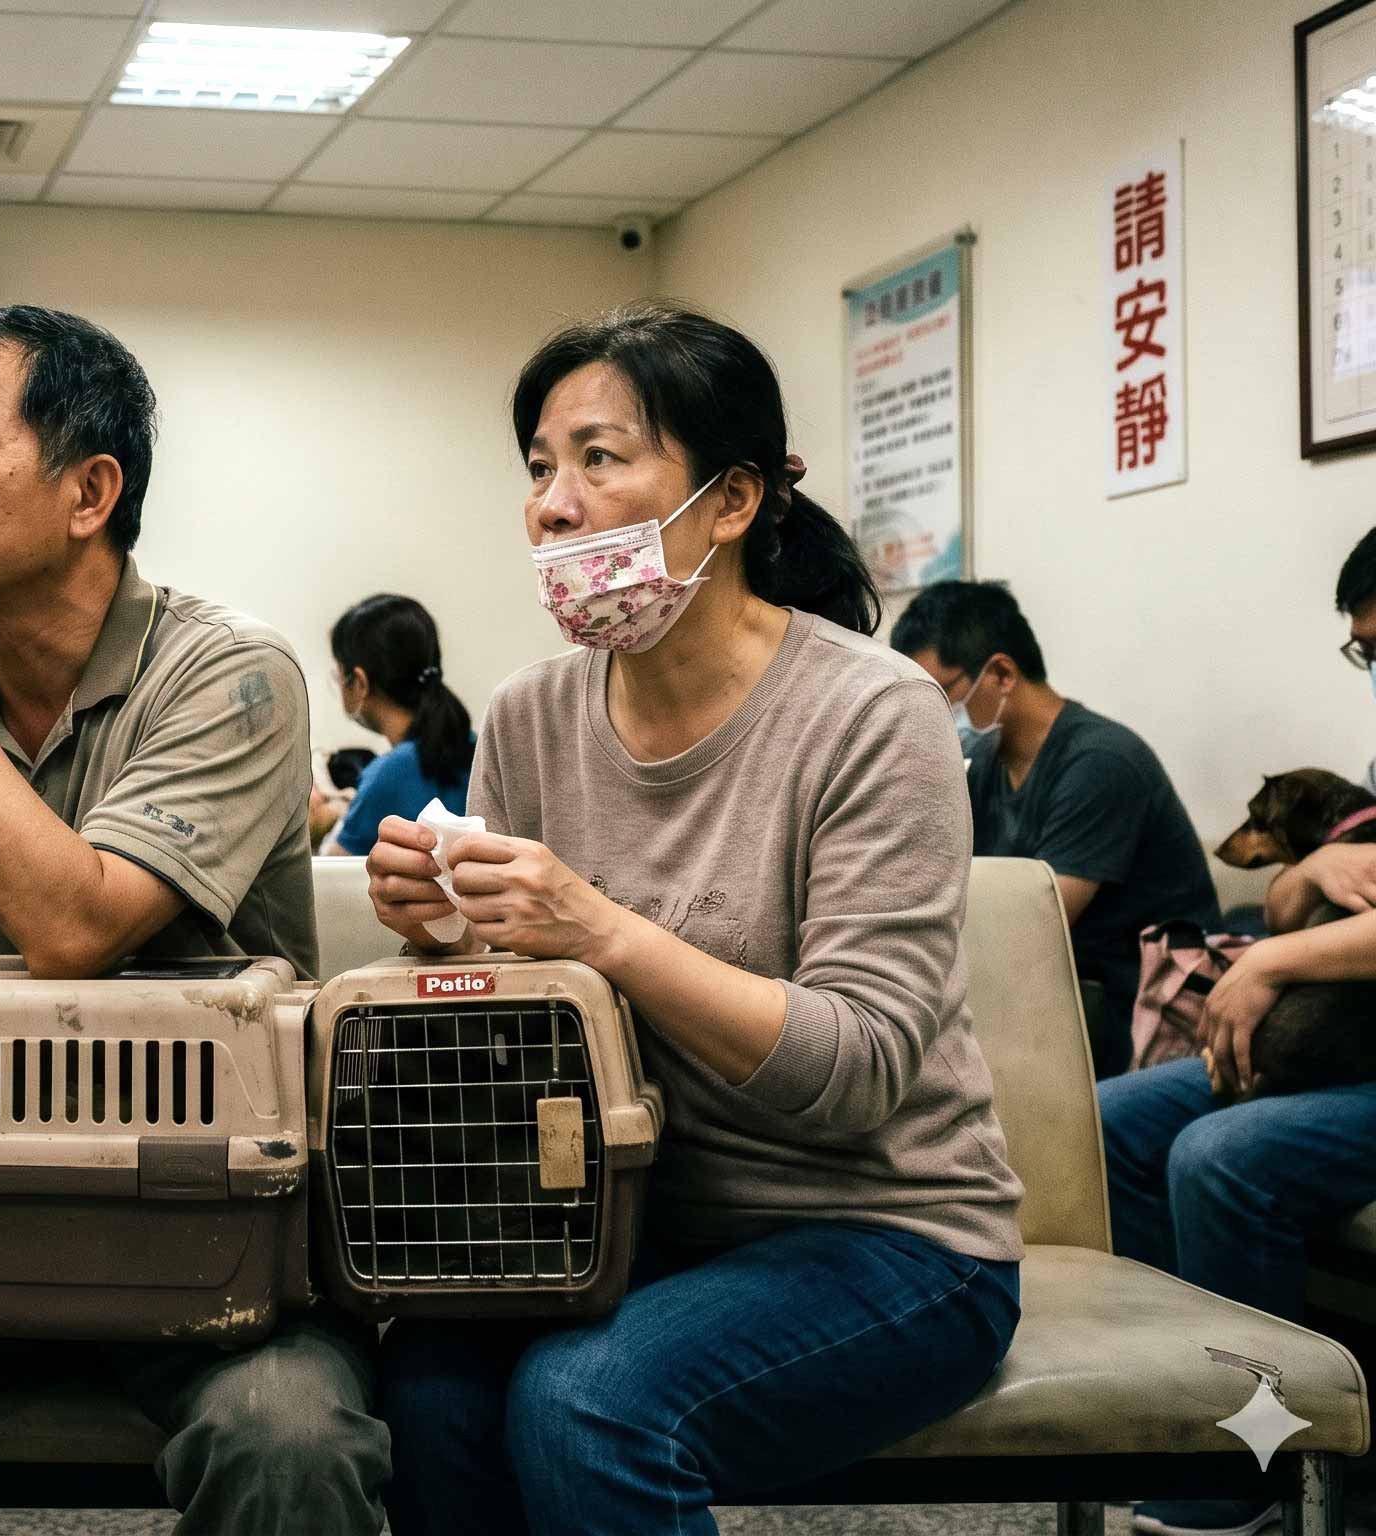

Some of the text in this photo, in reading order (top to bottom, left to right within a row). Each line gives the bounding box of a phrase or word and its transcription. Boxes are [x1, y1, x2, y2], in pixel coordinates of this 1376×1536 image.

[1114, 171, 1168, 473] 請安靜
[426, 975, 485, 992] Patio
